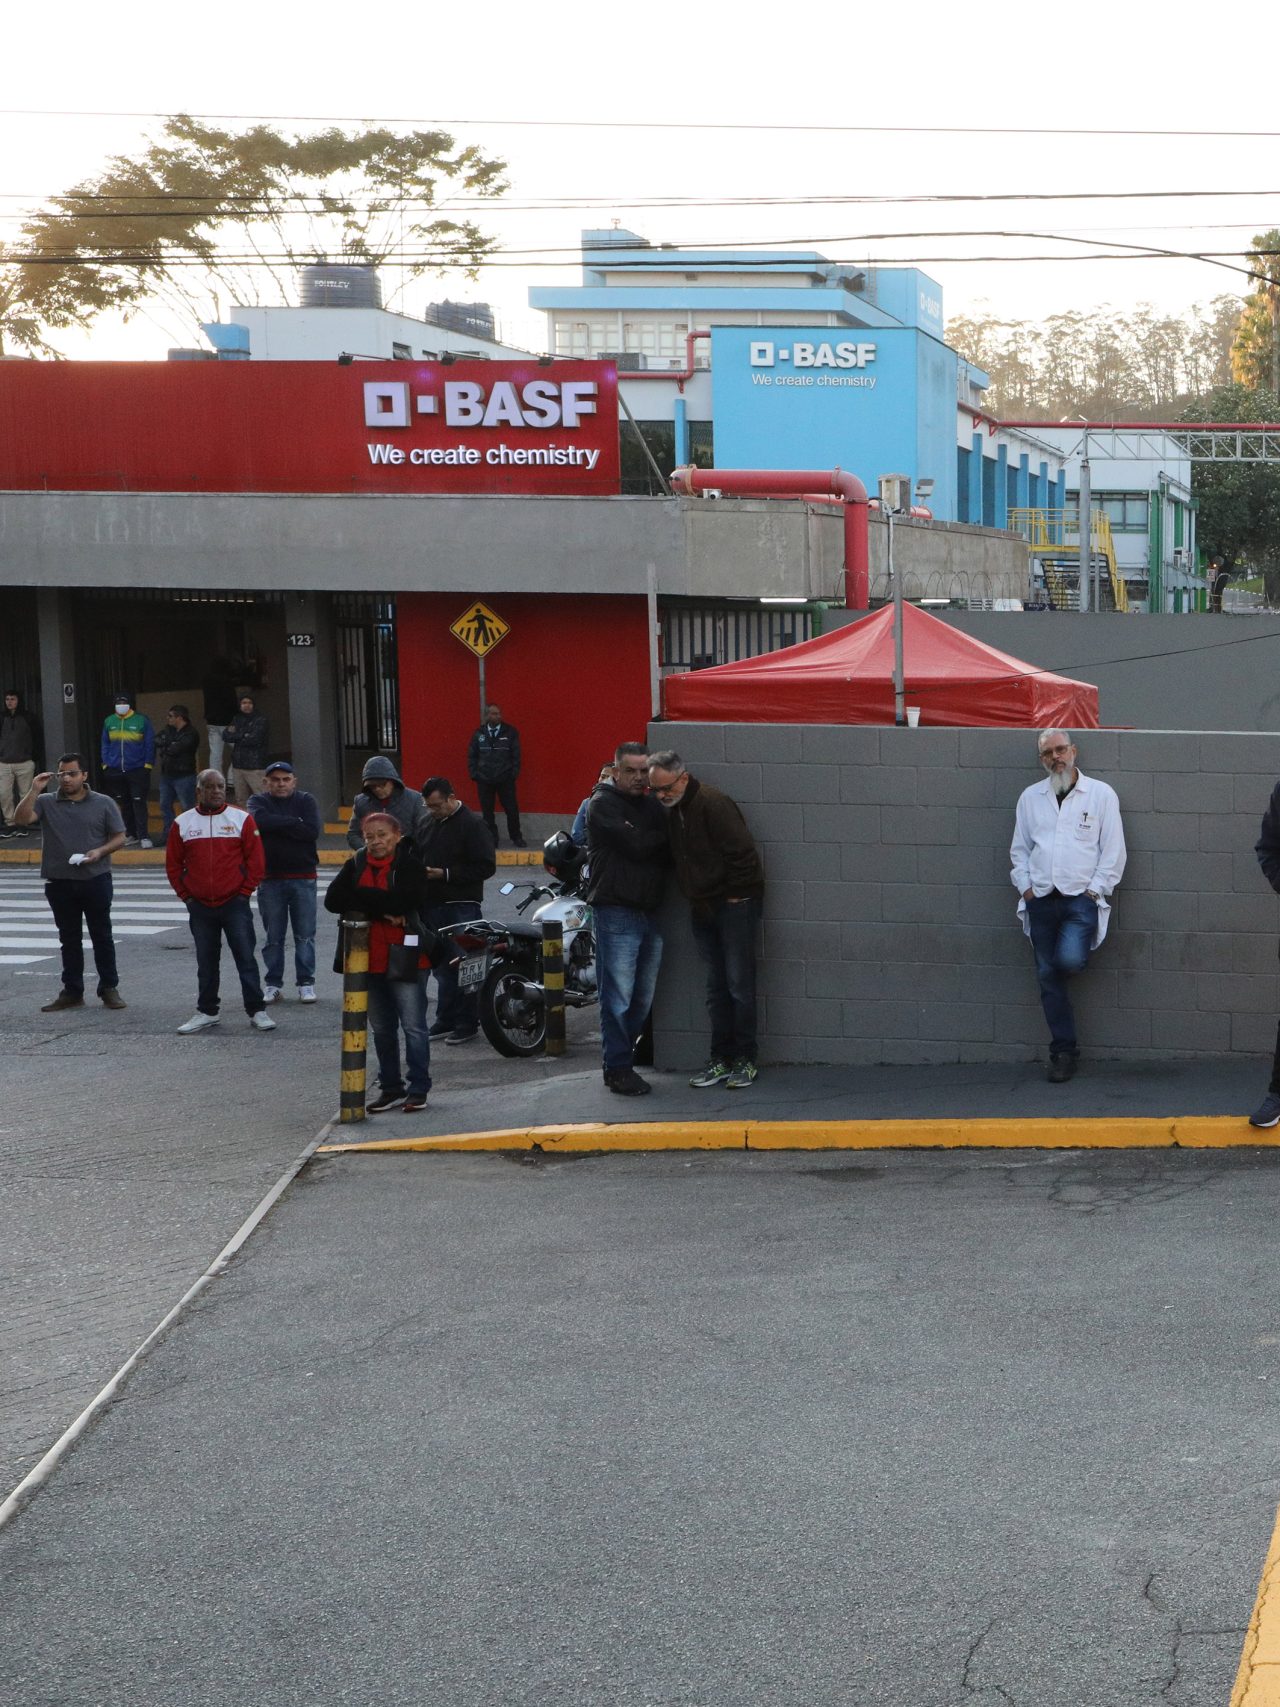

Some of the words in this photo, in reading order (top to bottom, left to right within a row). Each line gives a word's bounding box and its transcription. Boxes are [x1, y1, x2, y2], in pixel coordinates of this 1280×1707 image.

[793, 342, 876, 369] BASF
[752, 373, 772, 386] We
[775, 374, 814, 386] create
[817, 374, 876, 389] chemistry
[445, 381, 598, 428] BASF
[368, 443, 406, 465] We
[410, 444, 481, 465] create
[486, 443, 601, 470] chemistry
[290, 634, 311, 646] 123
